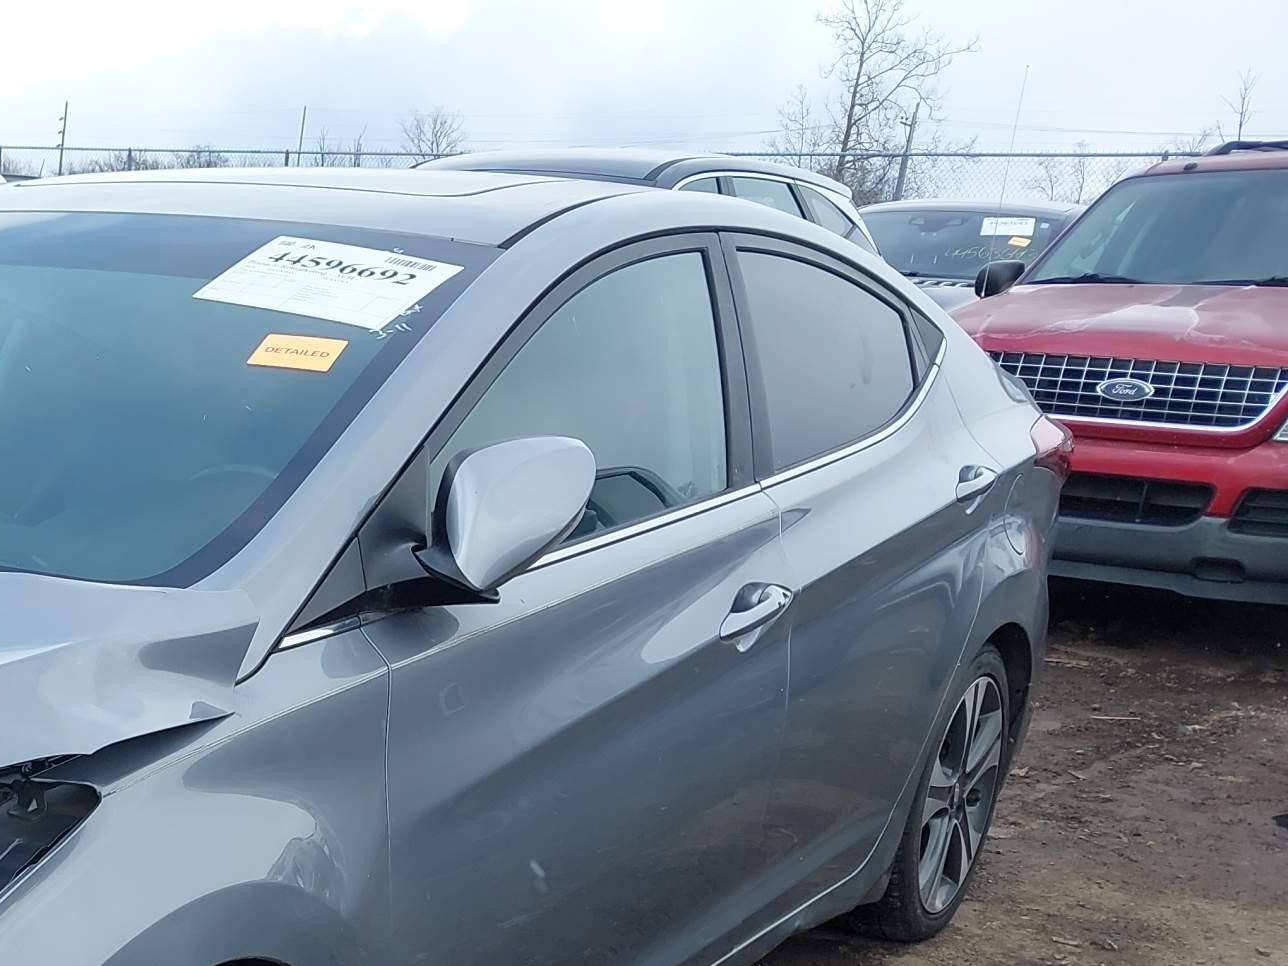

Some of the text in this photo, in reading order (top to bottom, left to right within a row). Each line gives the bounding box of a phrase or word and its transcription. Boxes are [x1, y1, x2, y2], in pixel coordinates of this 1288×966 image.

[269, 252, 416, 285] 44596692
[264, 346, 330, 358] DETAILED
[1112, 384, 1137, 395] Ford
